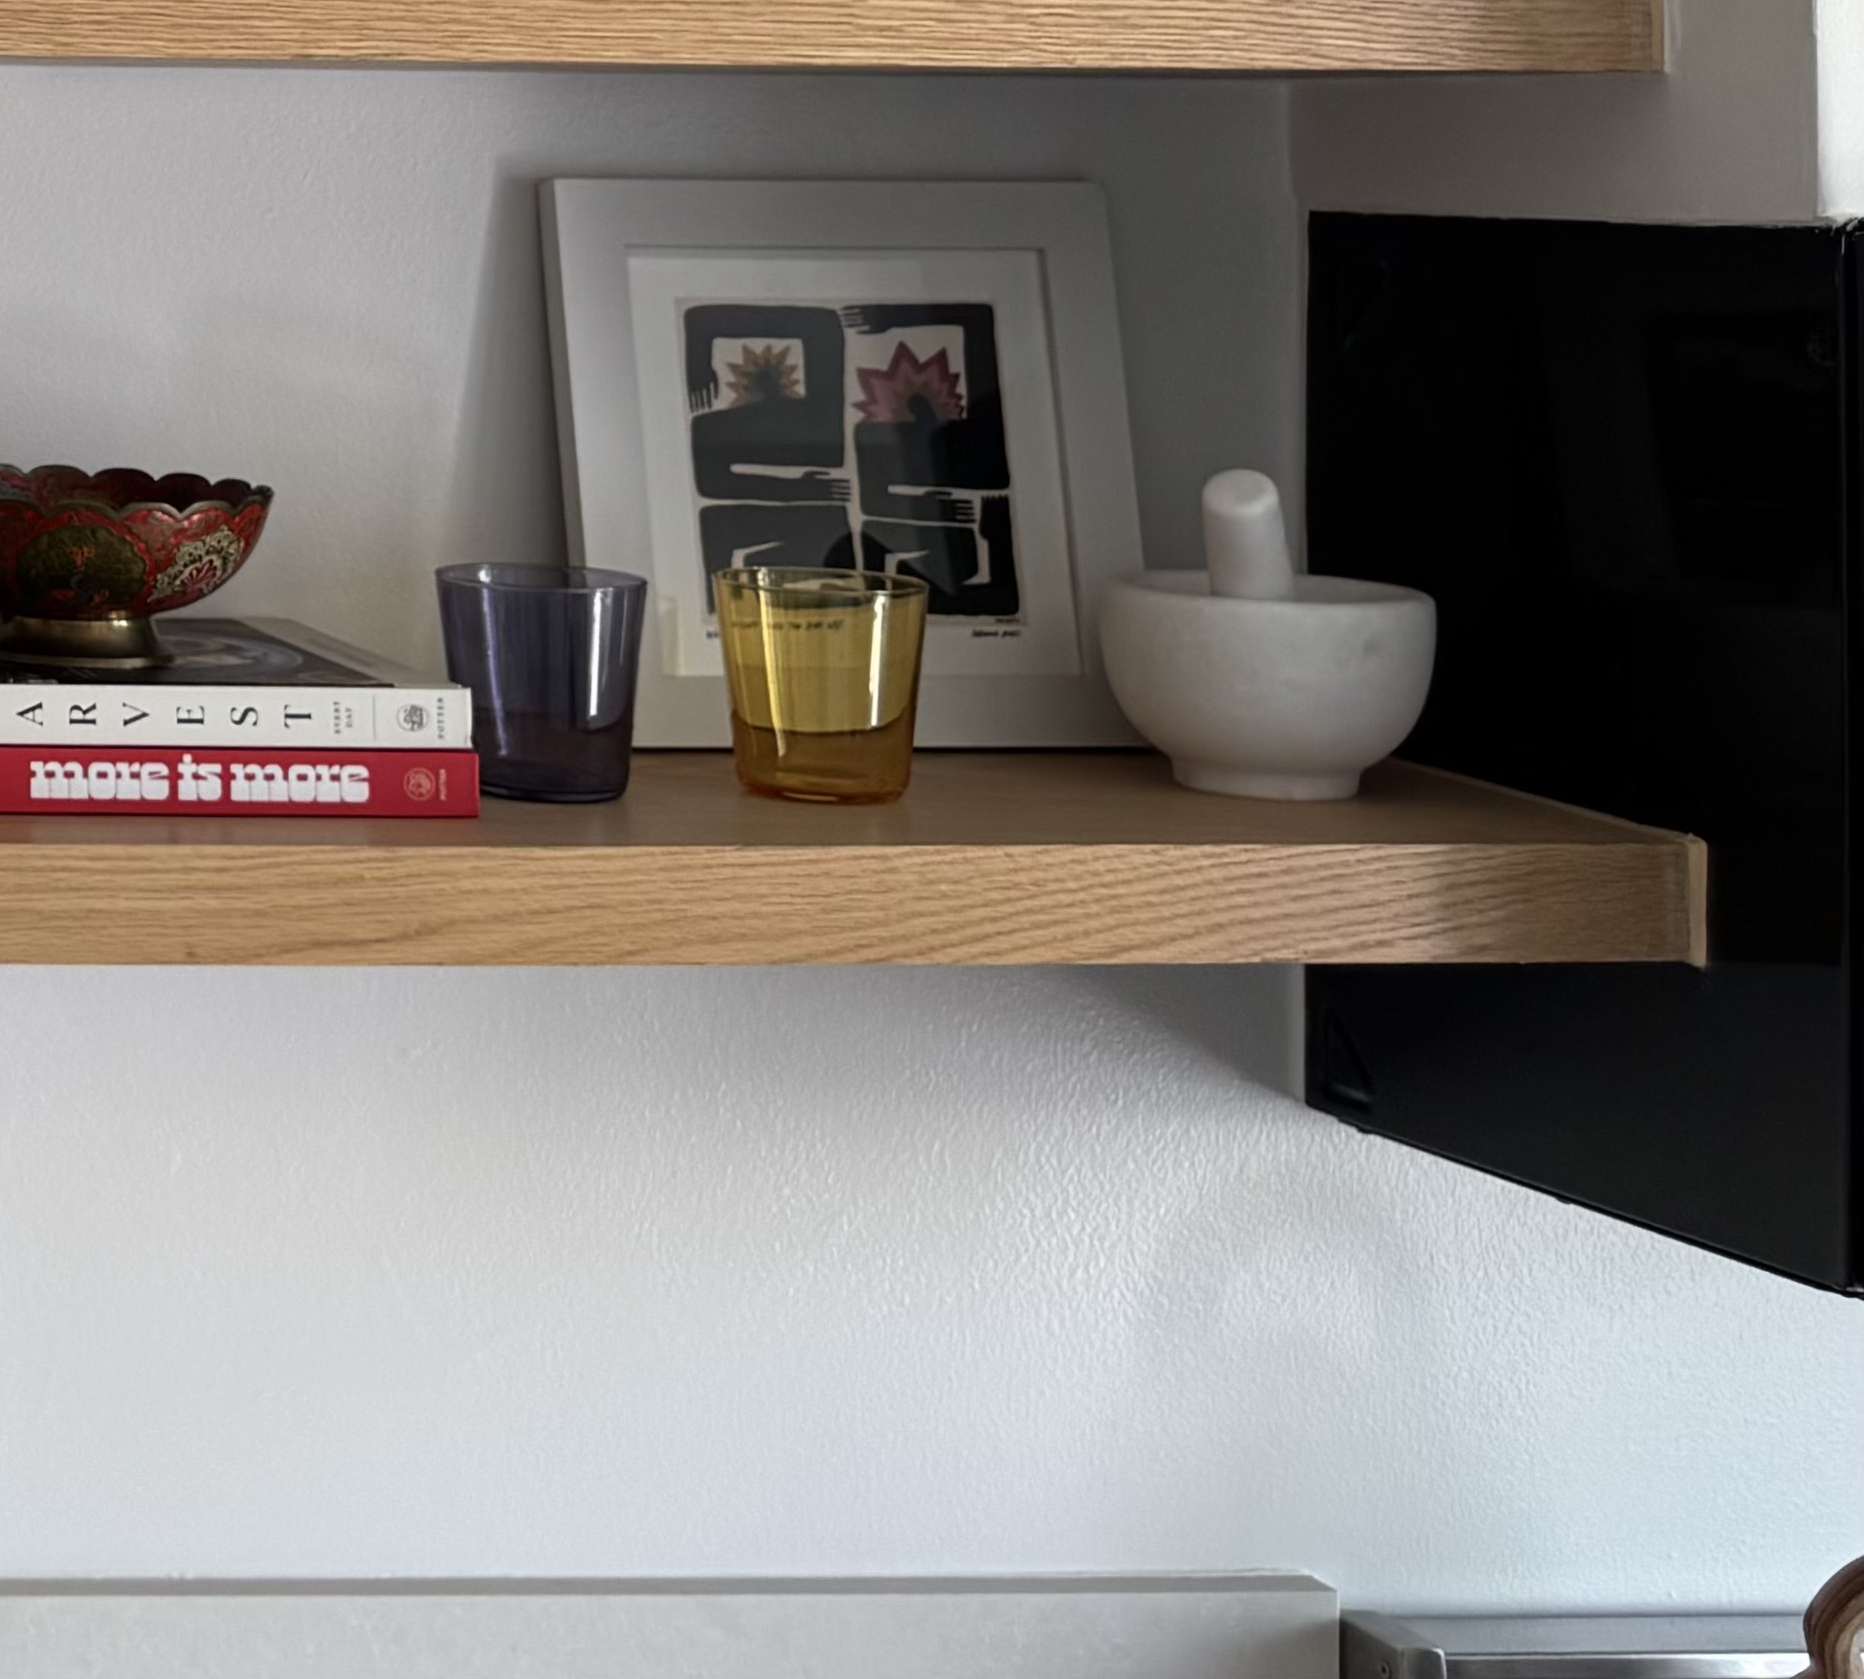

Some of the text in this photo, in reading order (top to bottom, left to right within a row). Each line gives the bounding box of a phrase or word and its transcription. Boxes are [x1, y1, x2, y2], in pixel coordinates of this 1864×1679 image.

[30, 753, 370, 804] more is more
